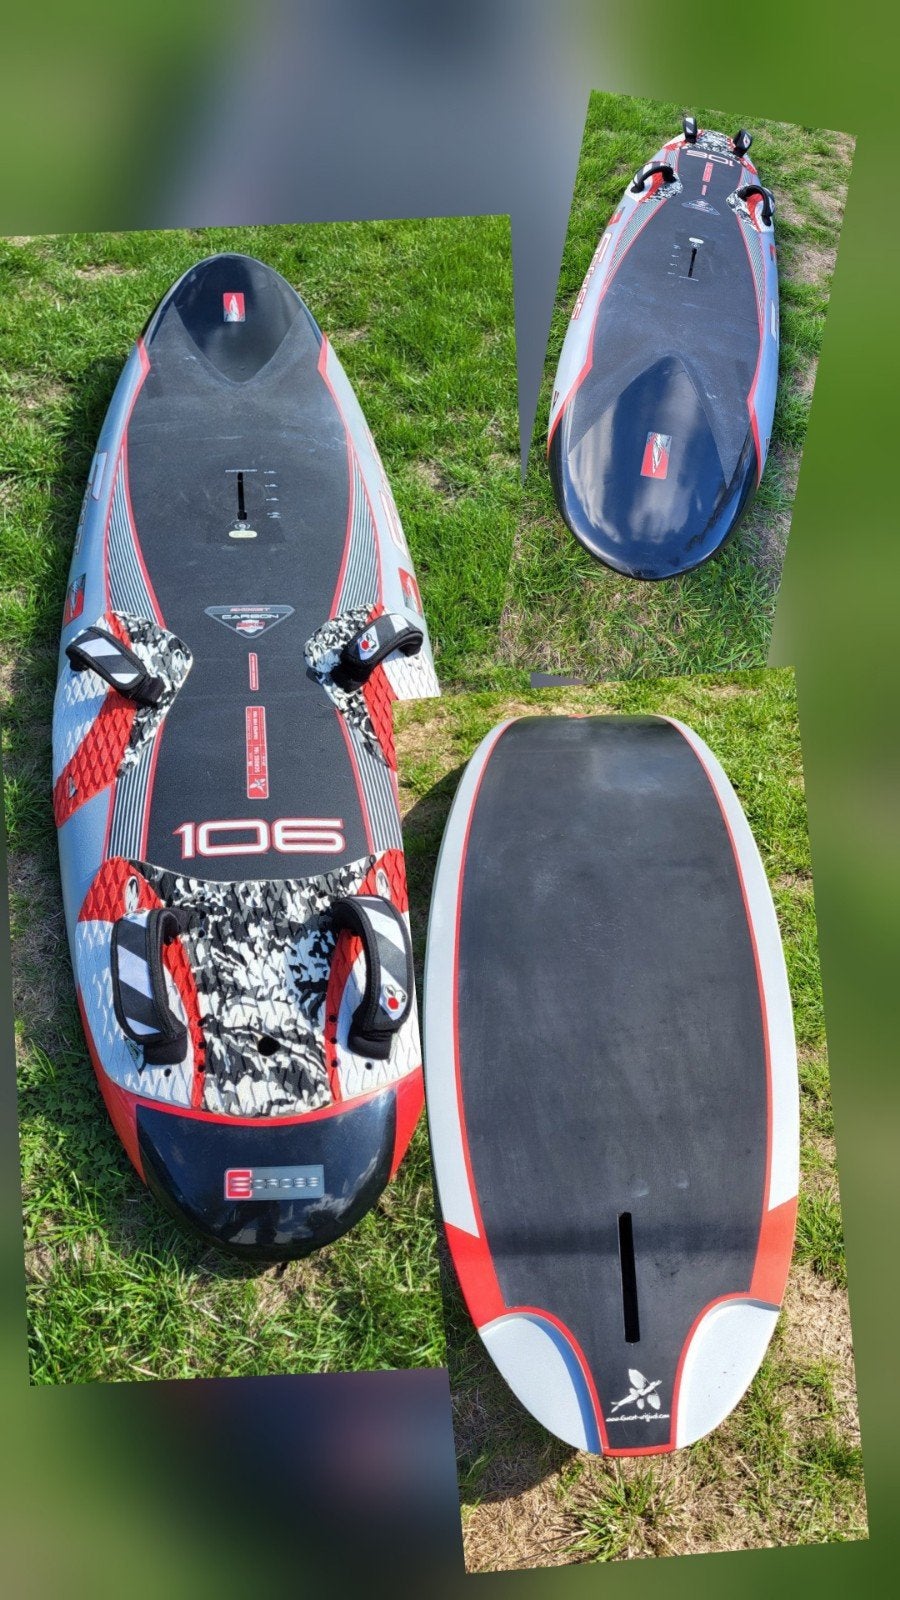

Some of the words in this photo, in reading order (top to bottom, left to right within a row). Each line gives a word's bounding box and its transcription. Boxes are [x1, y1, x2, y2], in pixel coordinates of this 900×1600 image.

[686, 149, 735, 167] 106
[221, 613, 280, 621] CARBON
[172, 817, 346, 860] 106
